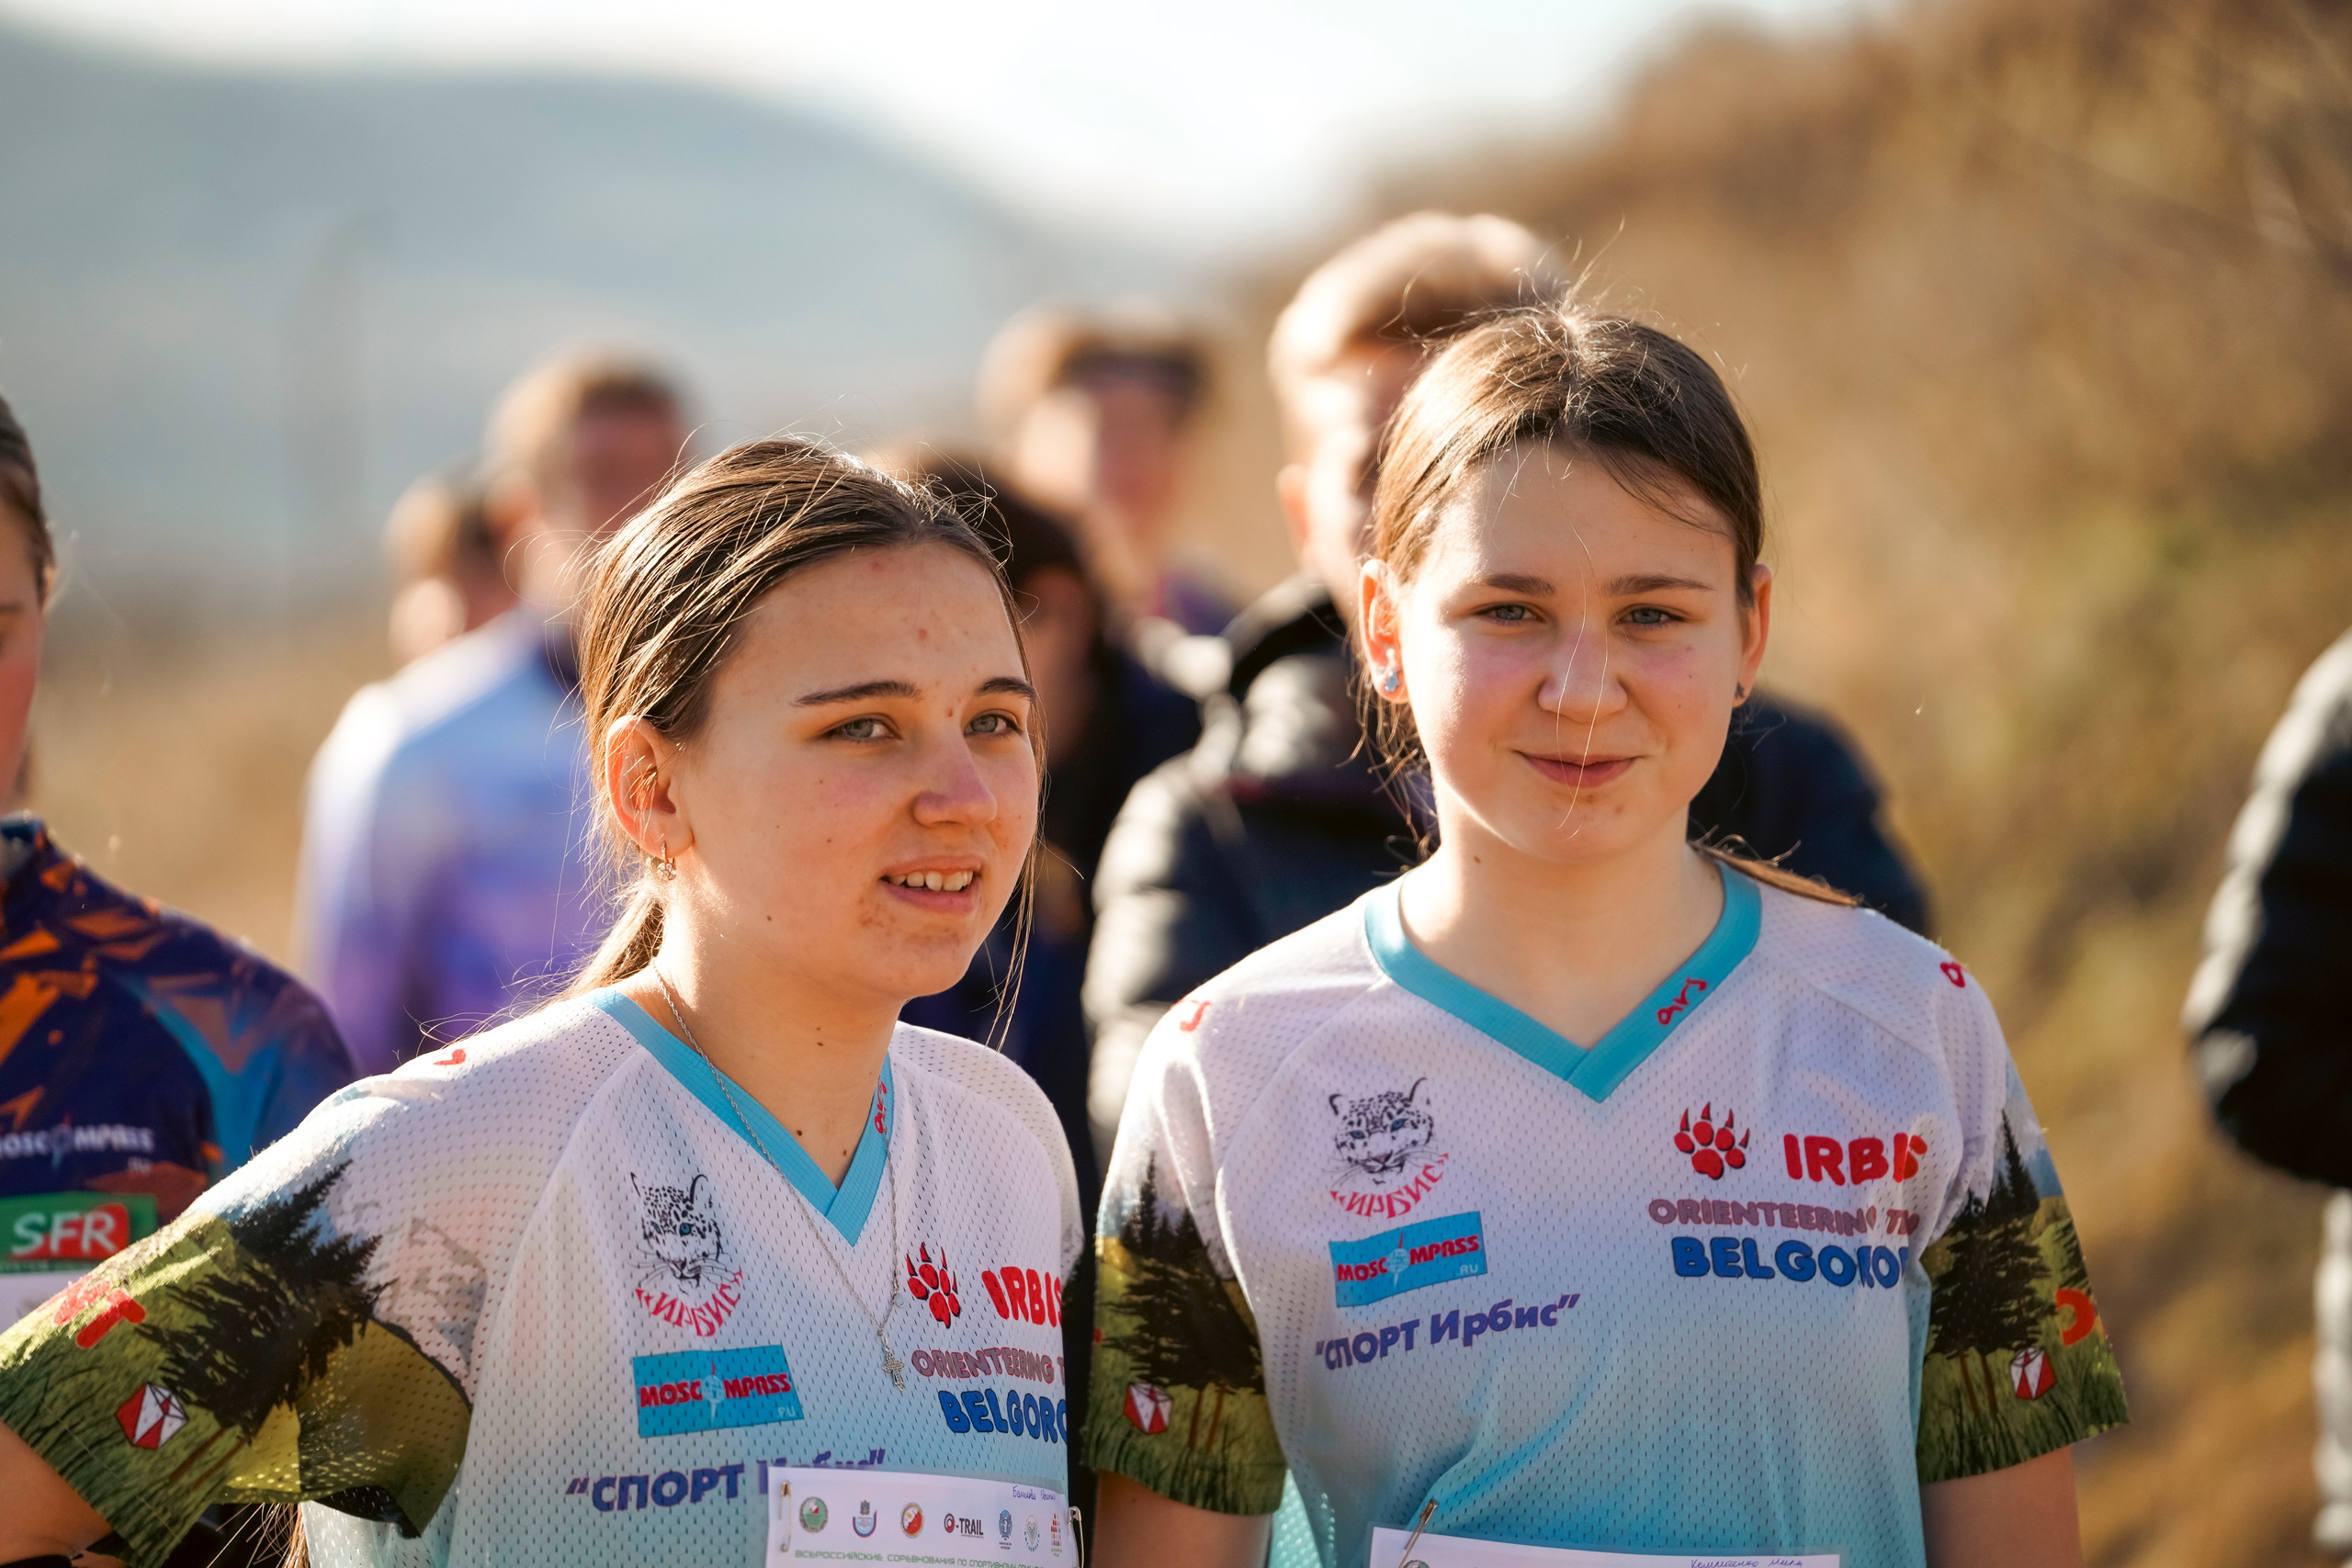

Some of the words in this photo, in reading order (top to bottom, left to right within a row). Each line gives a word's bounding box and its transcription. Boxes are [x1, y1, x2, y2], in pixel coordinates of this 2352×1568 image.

[11, 1210, 119, 1255] SFR
[911, 1347, 1055, 1385] ORIENTEERING
[795, 1549, 883, 1562] ВСЕРОССИЙСКИЕ
[888, 1553, 956, 1565] СОРЕВНОВАНИЯ
